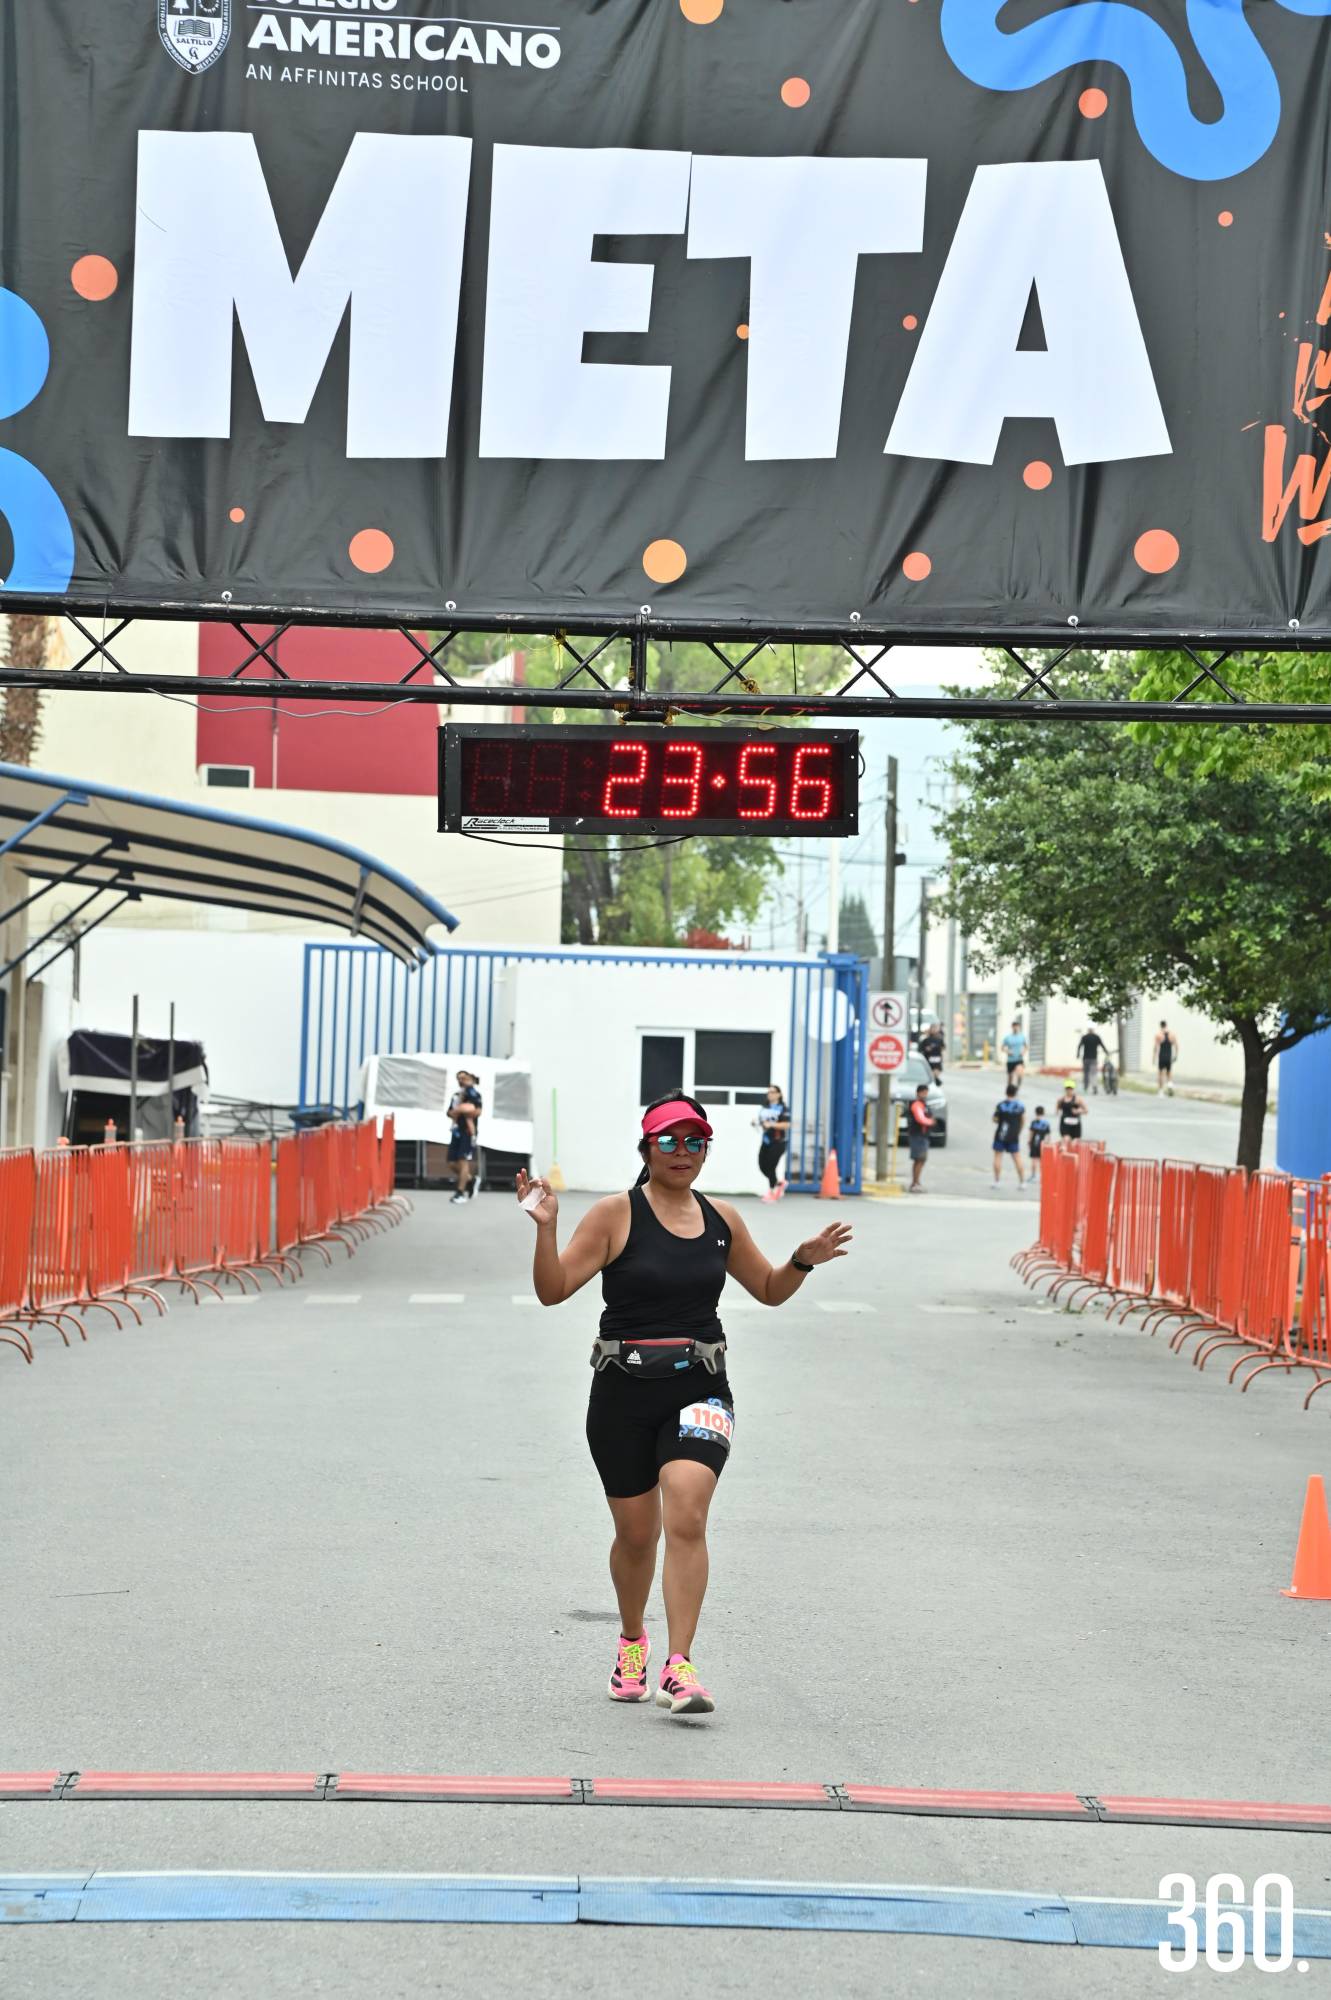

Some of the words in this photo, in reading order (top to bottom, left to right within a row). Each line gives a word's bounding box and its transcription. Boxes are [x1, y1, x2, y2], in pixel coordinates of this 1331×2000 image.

[176, 38, 213, 46] SALTILLO
[247, 14, 561, 69] AMERICANO
[246, 64, 272, 81] AN
[280, 66, 383, 89] AFFINITAS
[390, 73, 469, 93] SCHOOL
[128, 130, 1172, 465] META
[692, 1407, 731, 1439] 1103
